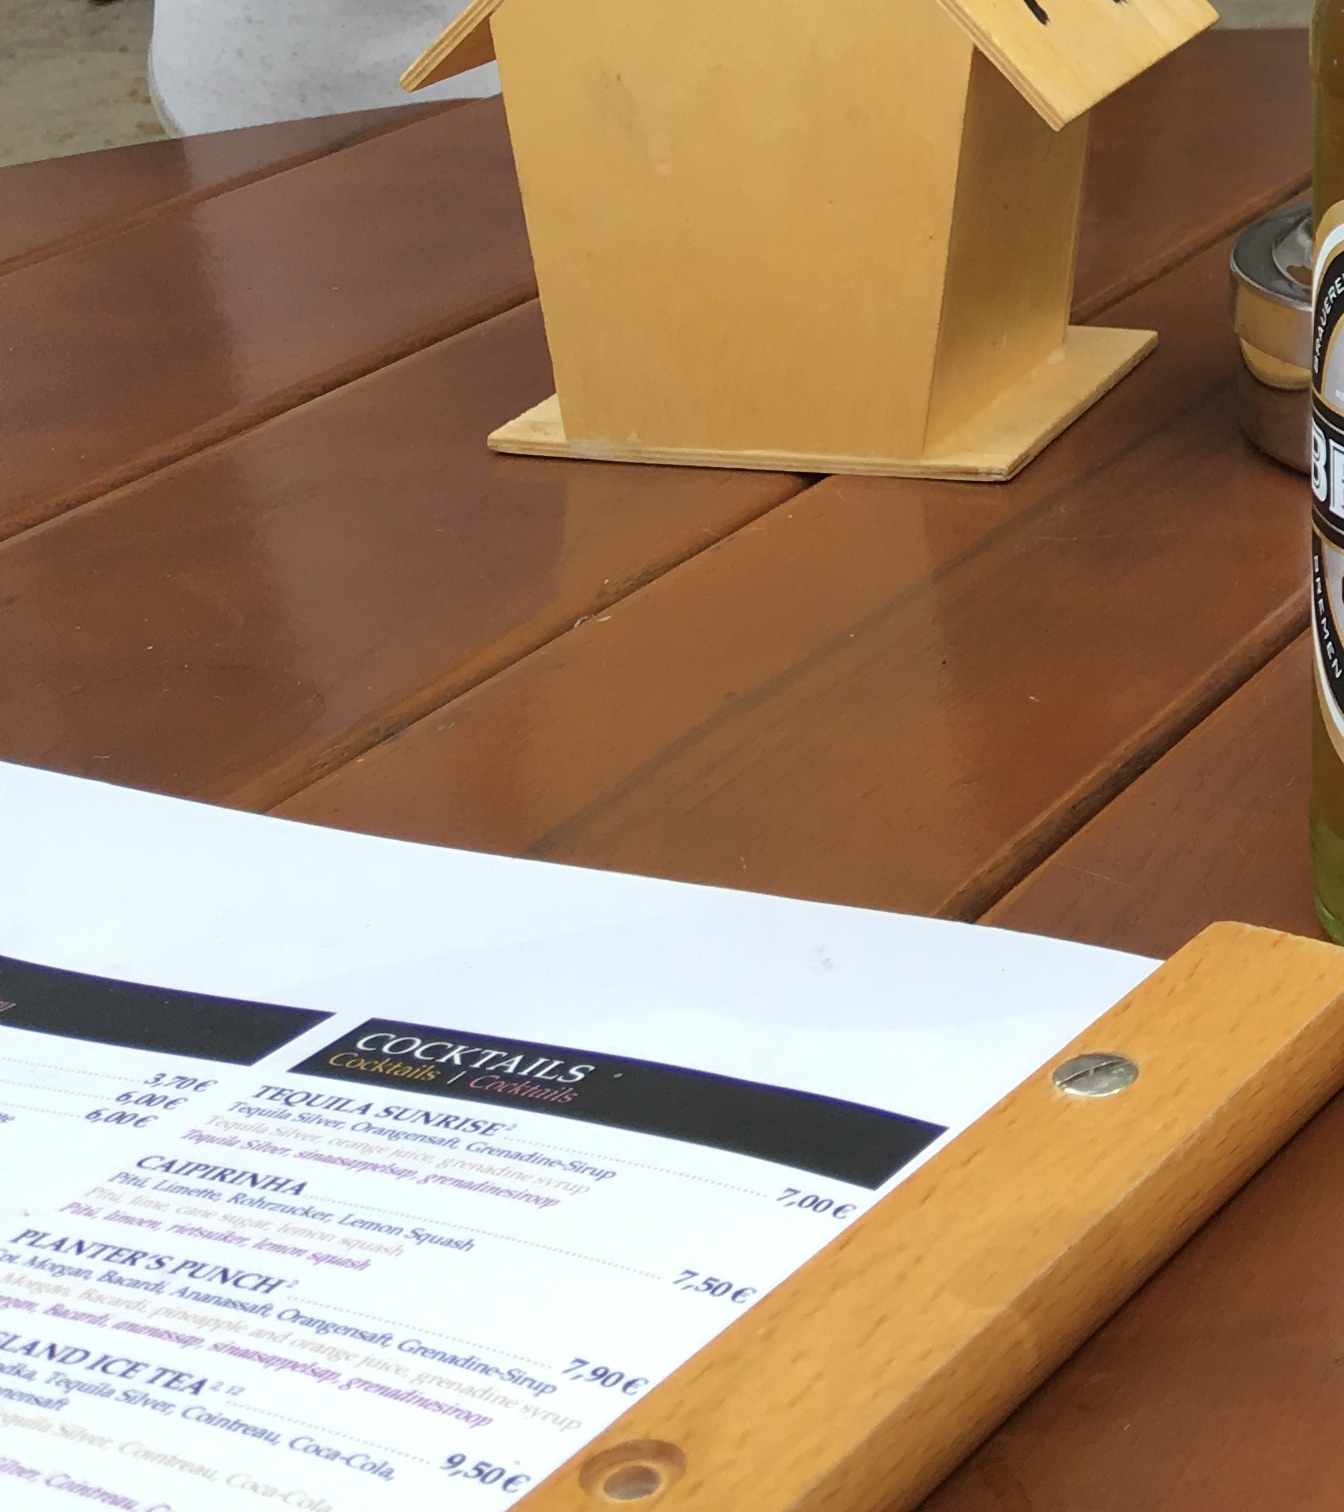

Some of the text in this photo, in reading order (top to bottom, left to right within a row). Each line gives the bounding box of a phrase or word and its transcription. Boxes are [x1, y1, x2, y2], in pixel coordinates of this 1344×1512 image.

[328, 1051, 580, 1105] Cocktails Cocktails
[355, 1031, 596, 1084] COCKTAILS
[250, 1084, 375, 1116] TEQUILA
[373, 1104, 504, 1137] SUNRISE
[226, 1100, 293, 1119] Tequila
[465, 1140, 617, 1183] Grenadine-Sirup
[135, 1155, 309, 1196] CAIPIRINHA
[336, 1212, 405, 1237] Lemon
[403, 1226, 476, 1253] Squash
[8, 1228, 175, 1271] PLANTER'S
[167, 1259, 287, 1295] PUNCH
[84, 1353, 151, 1380] ICE
[144, 1366, 209, 1396] TEA
[397, 1338, 558, 1398] Grenadine-Sirup
